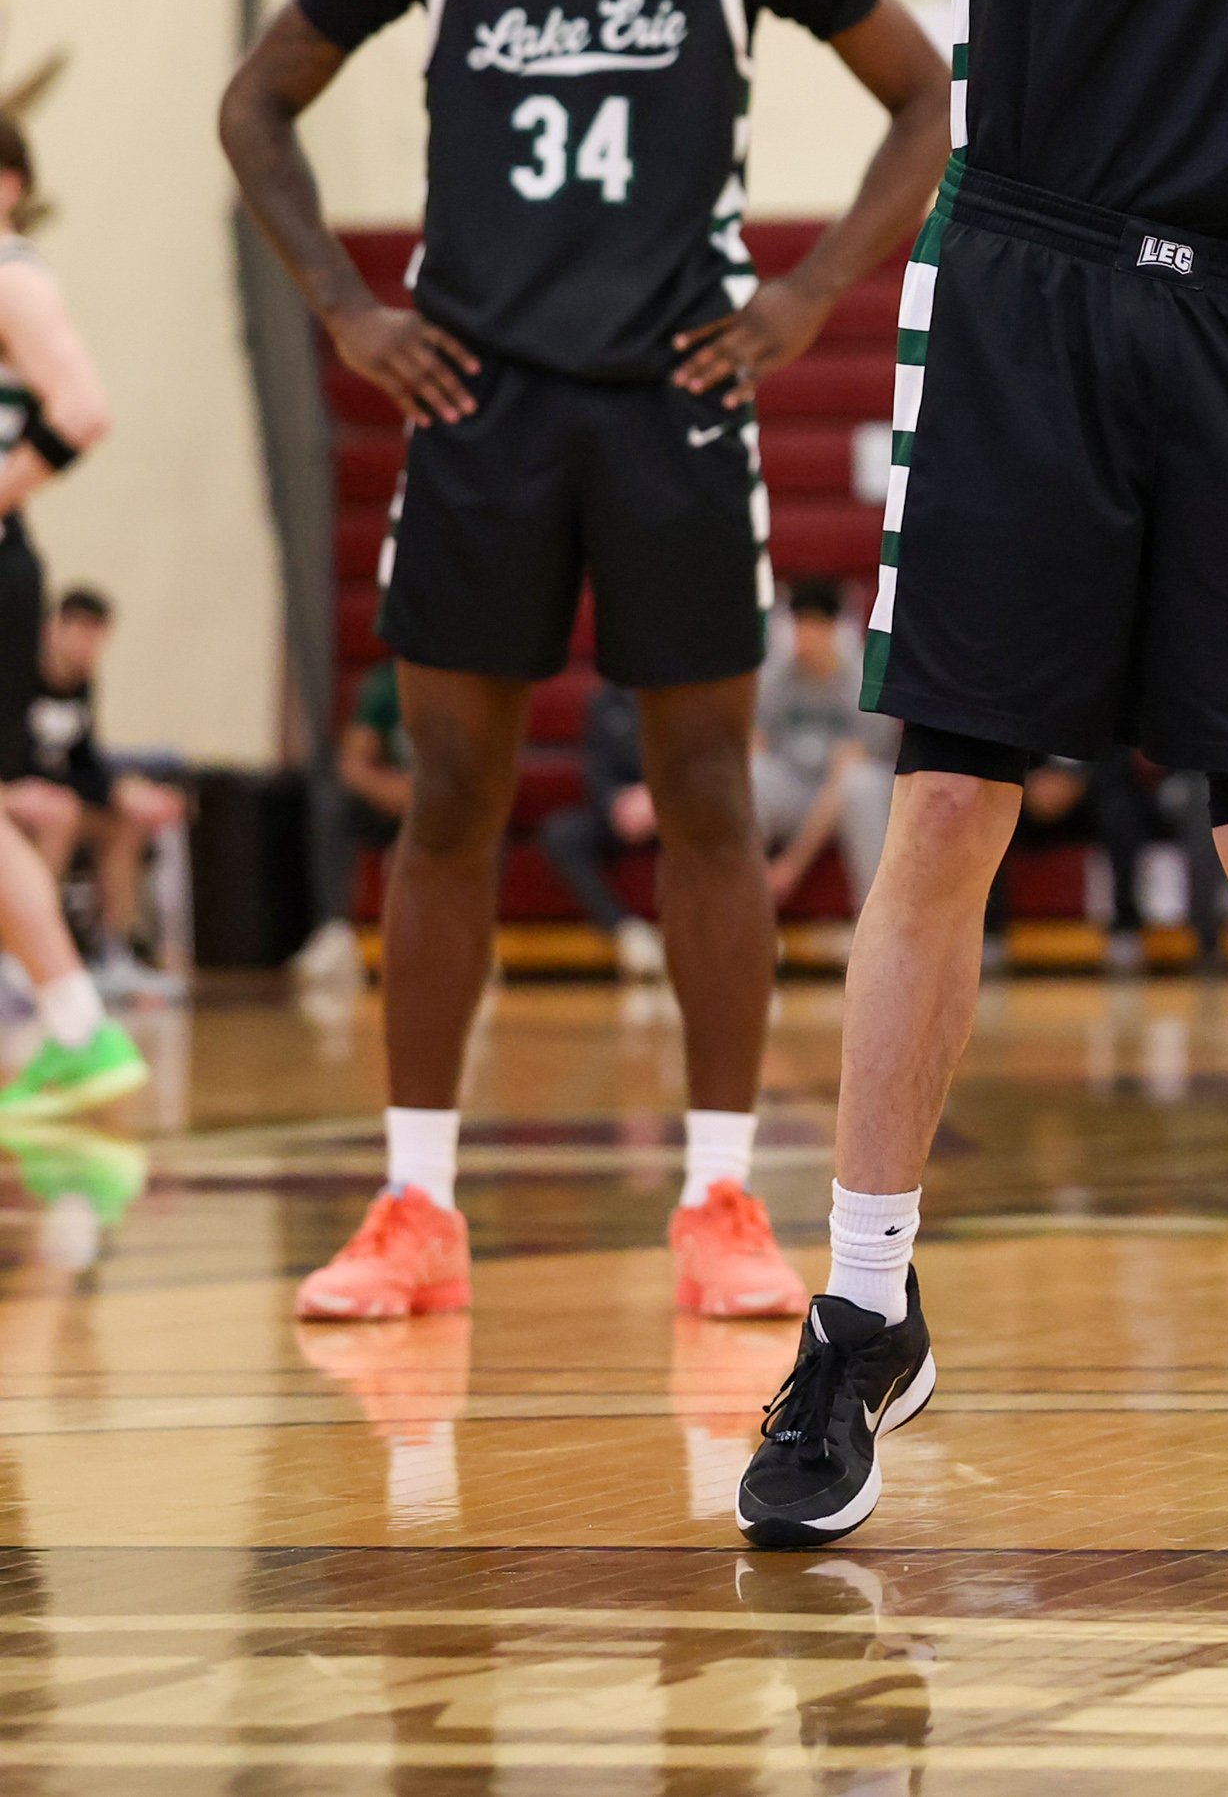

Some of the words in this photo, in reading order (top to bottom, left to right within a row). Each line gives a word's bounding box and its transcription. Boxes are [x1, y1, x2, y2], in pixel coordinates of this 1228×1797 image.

[467, 5, 592, 71] Lake
[509, 93, 635, 202] 34
[1136, 236, 1195, 275] LEC
